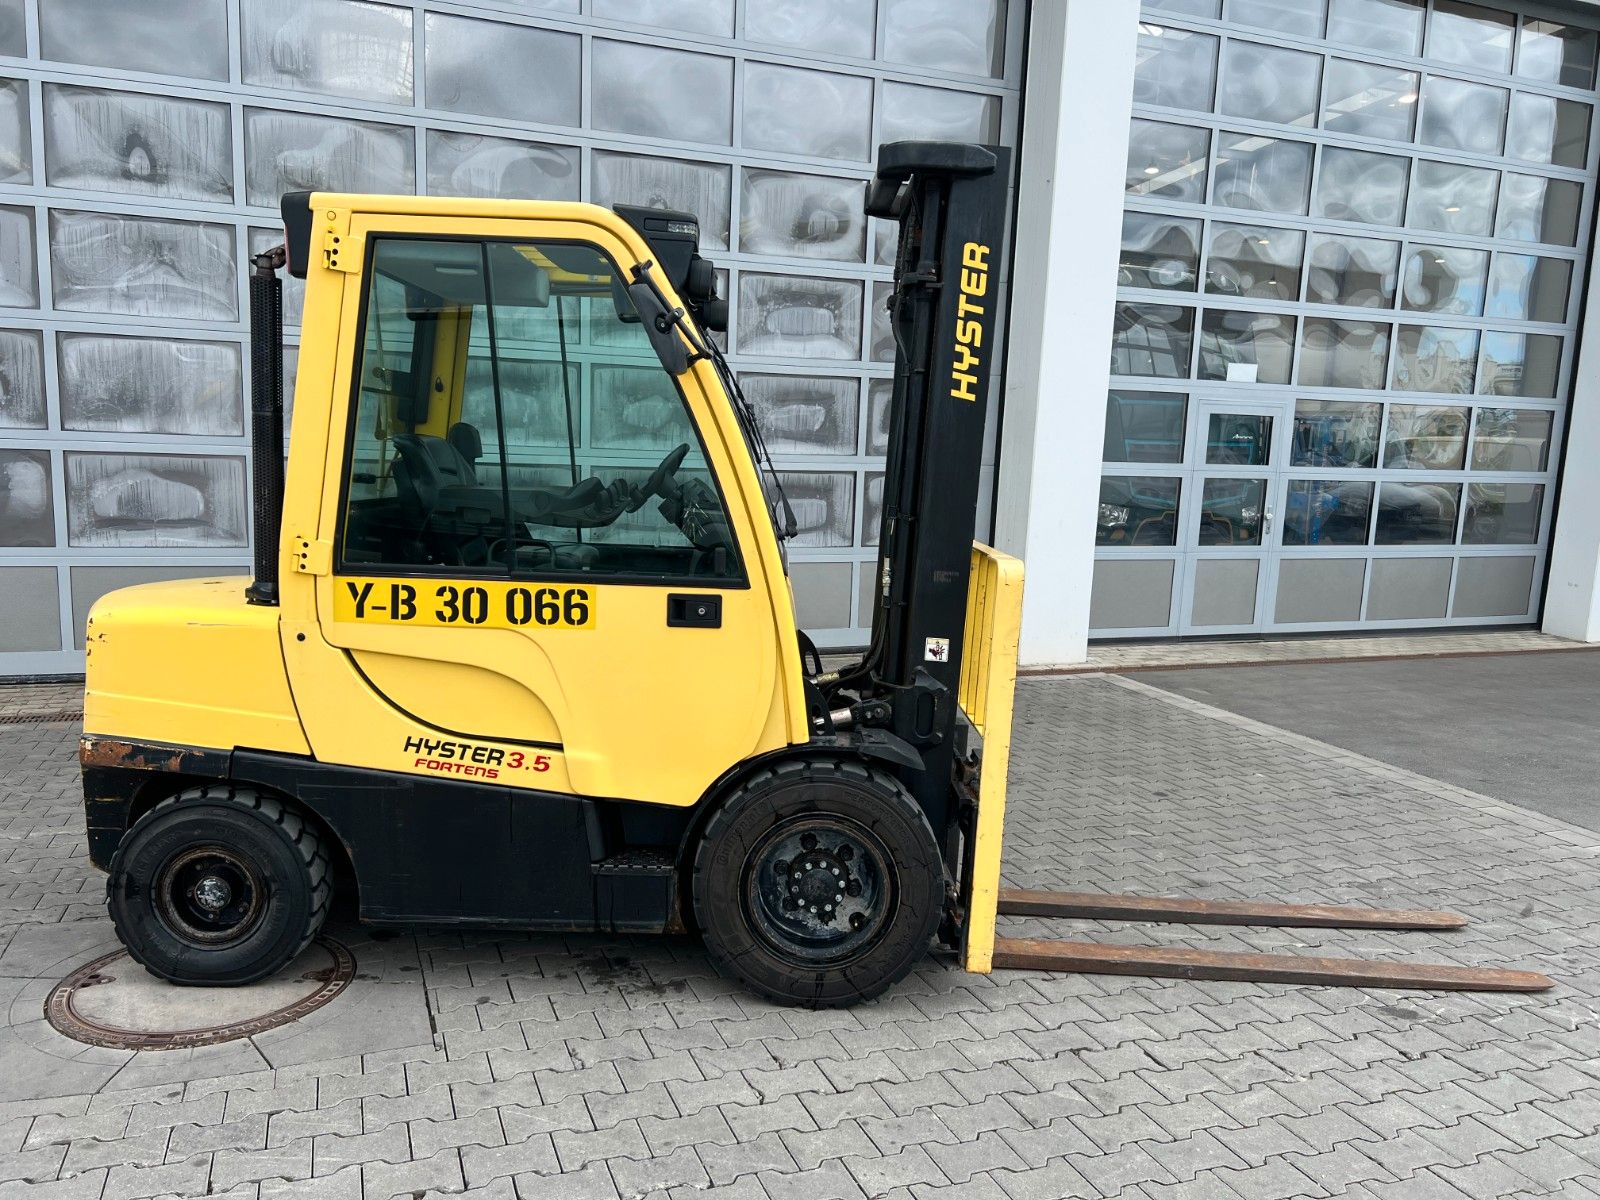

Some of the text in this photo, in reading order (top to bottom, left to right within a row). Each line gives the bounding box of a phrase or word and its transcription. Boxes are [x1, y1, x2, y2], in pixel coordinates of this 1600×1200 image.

[950, 241, 990, 402] HYSTER
[346, 581, 589, 626] Y-B 30 066
[403, 736, 551, 773] HYSTER 3.5
[414, 758, 500, 779] FORTENS
